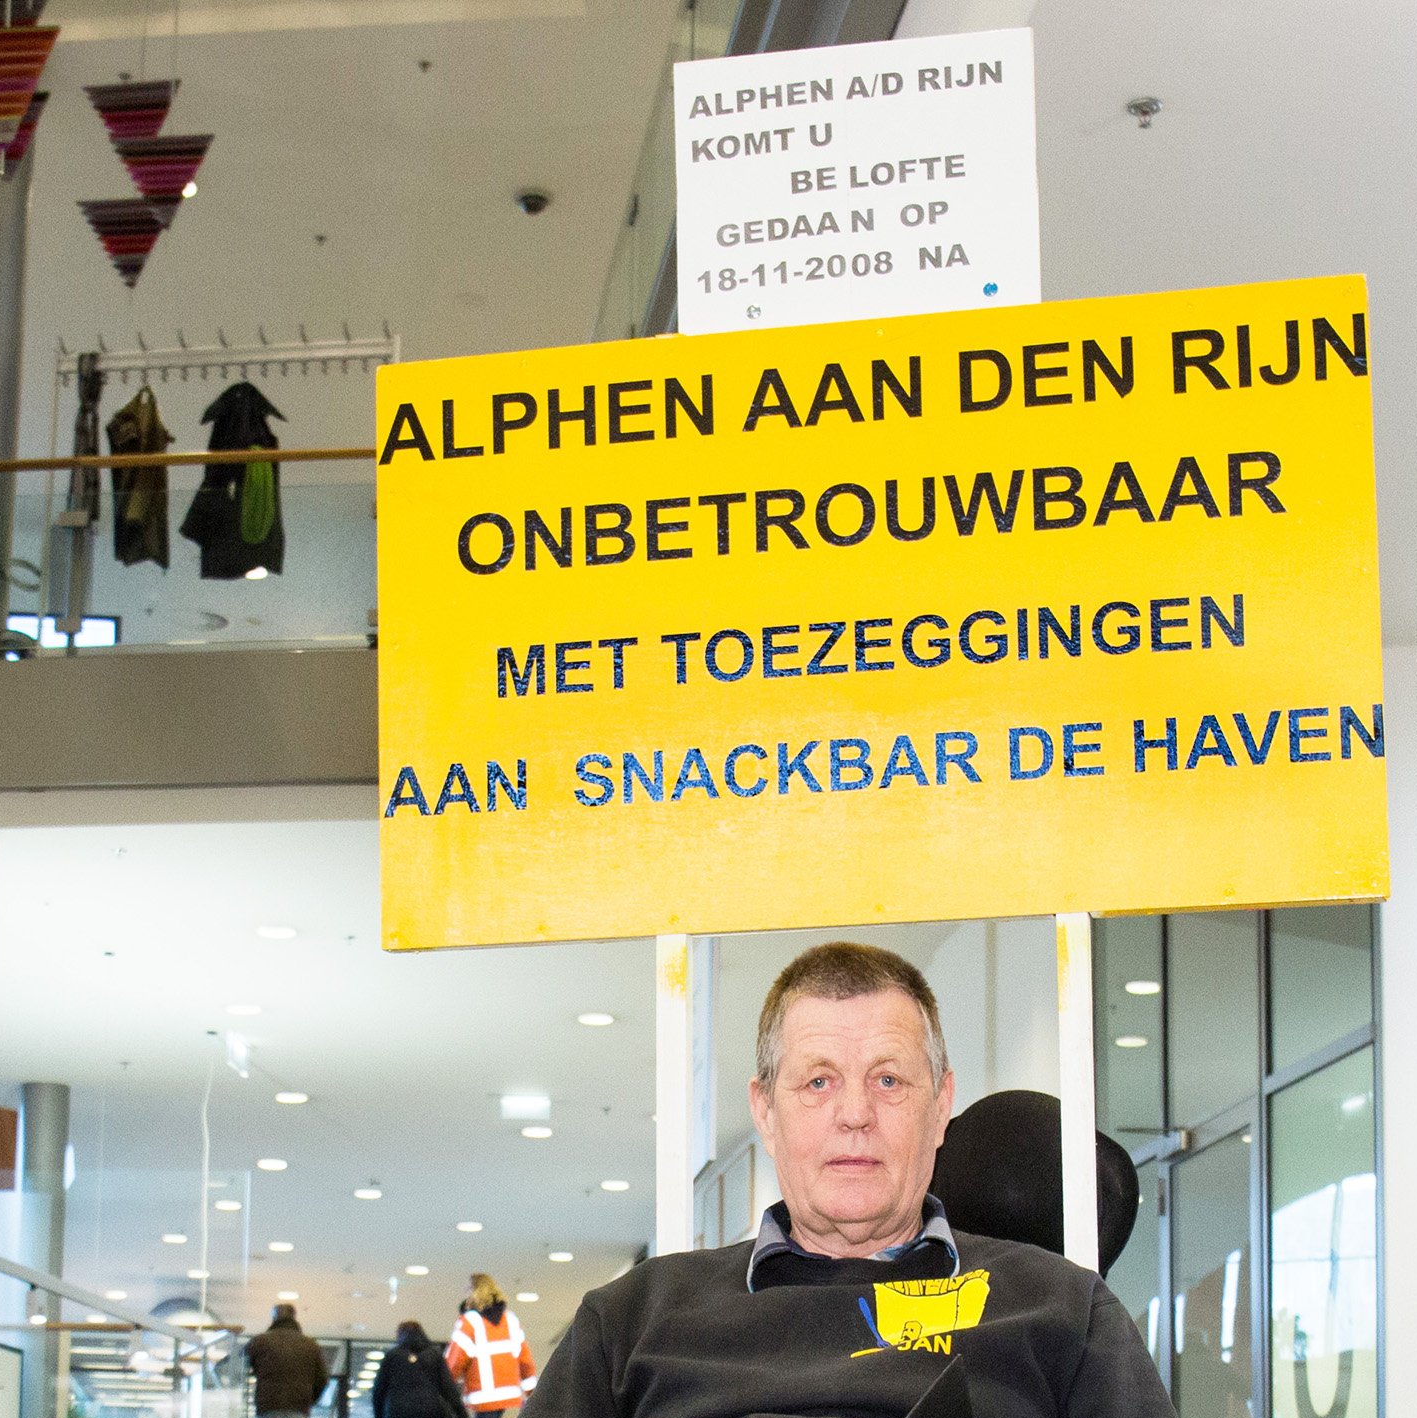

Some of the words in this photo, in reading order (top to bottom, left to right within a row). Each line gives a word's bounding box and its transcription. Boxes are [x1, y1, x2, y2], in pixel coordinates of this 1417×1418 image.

[689, 78, 834, 119] ALPHEN
[846, 72, 904, 99] A/D
[918, 60, 1003, 92] RIJN
[692, 127, 796, 162] KOMT
[809, 122, 833, 147] U
[900, 201, 950, 227] OP
[698, 250, 894, 294] 18-11-2008
[918, 243, 970, 270] NA
[379, 374, 714, 465] ALPHEN
[742, 355, 923, 432] AAN
[958, 335, 1134, 413] DEN
[1172, 312, 1368, 393] RIJN
[457, 451, 1286, 575] ONBETROUWBAAR
[497, 637, 639, 698] MET
[660, 593, 1245, 684] TOEZEGGINGEN
[384, 759, 527, 818] AAN
[574, 730, 982, 807] SNACKBAR
[1009, 722, 1104, 780] DE
[1134, 703, 1385, 773] HAVEN
